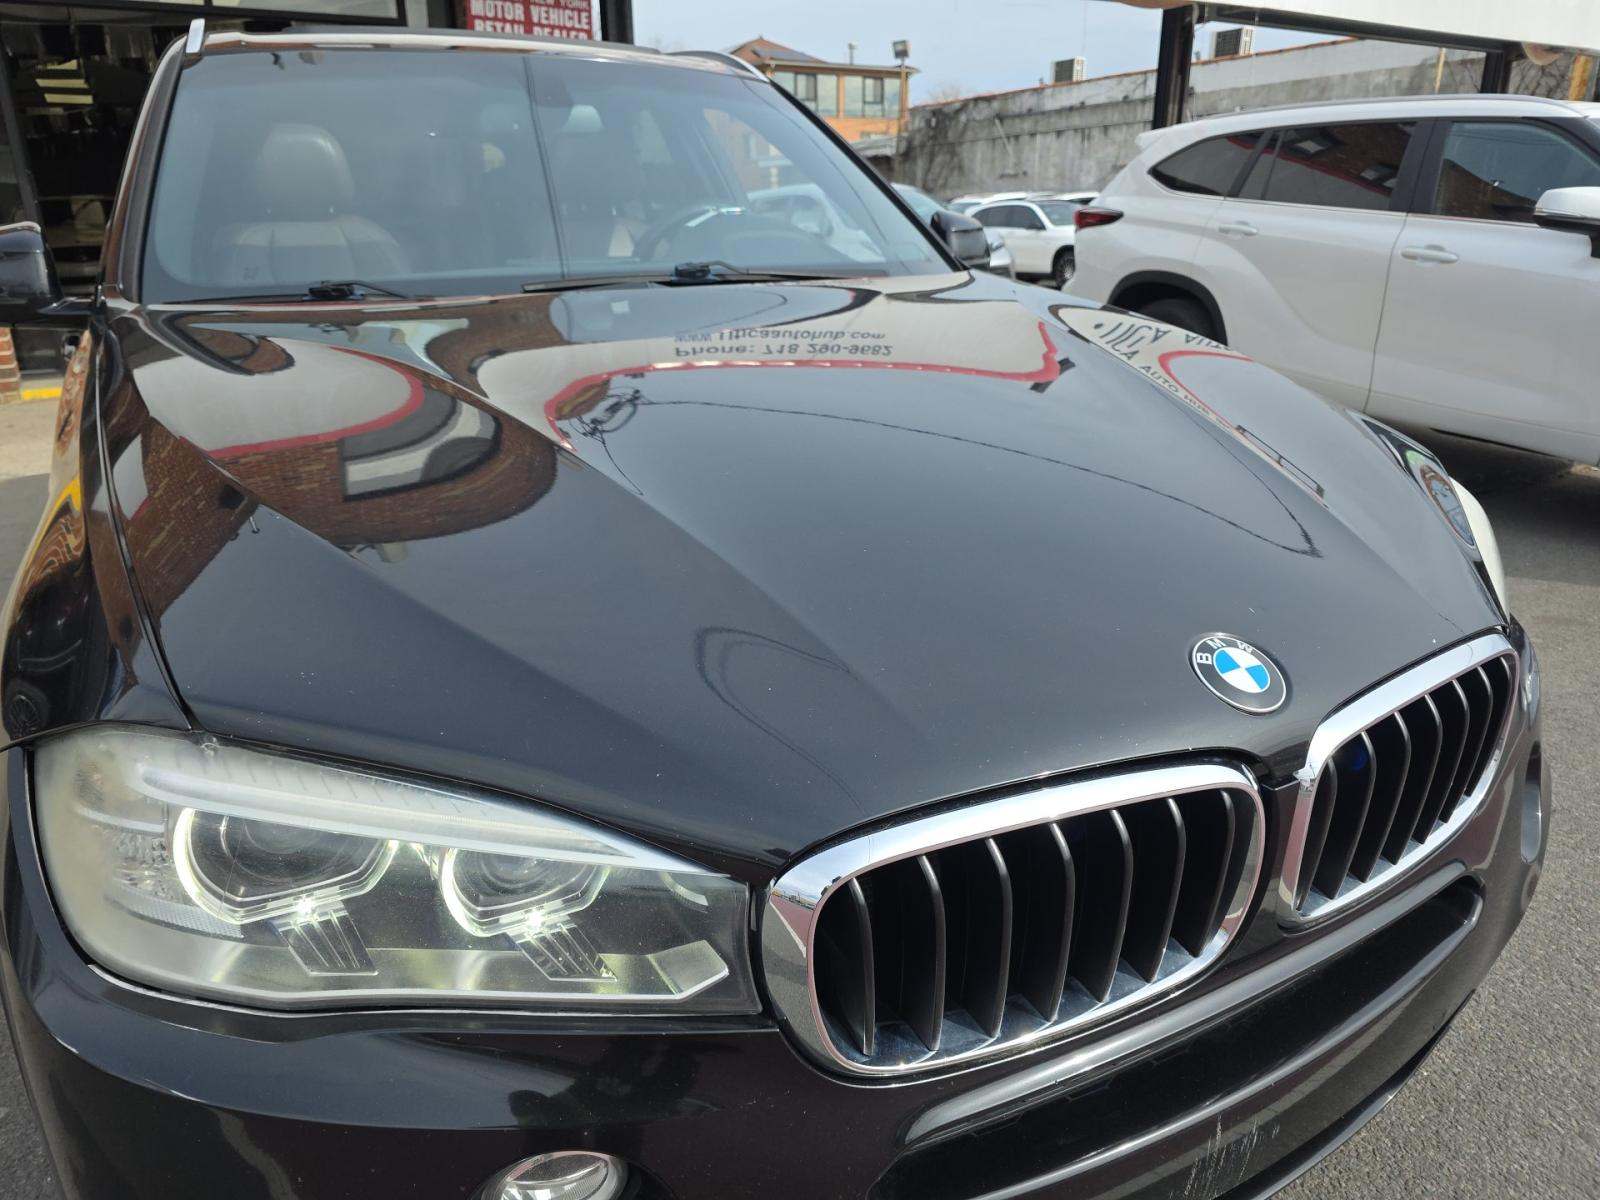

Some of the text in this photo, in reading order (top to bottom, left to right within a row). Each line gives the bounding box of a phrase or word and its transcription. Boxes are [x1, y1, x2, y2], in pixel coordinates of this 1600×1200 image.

[471, 0, 590, 29] MOTOR VEHICLE
[1196, 637, 1254, 665] BMW
